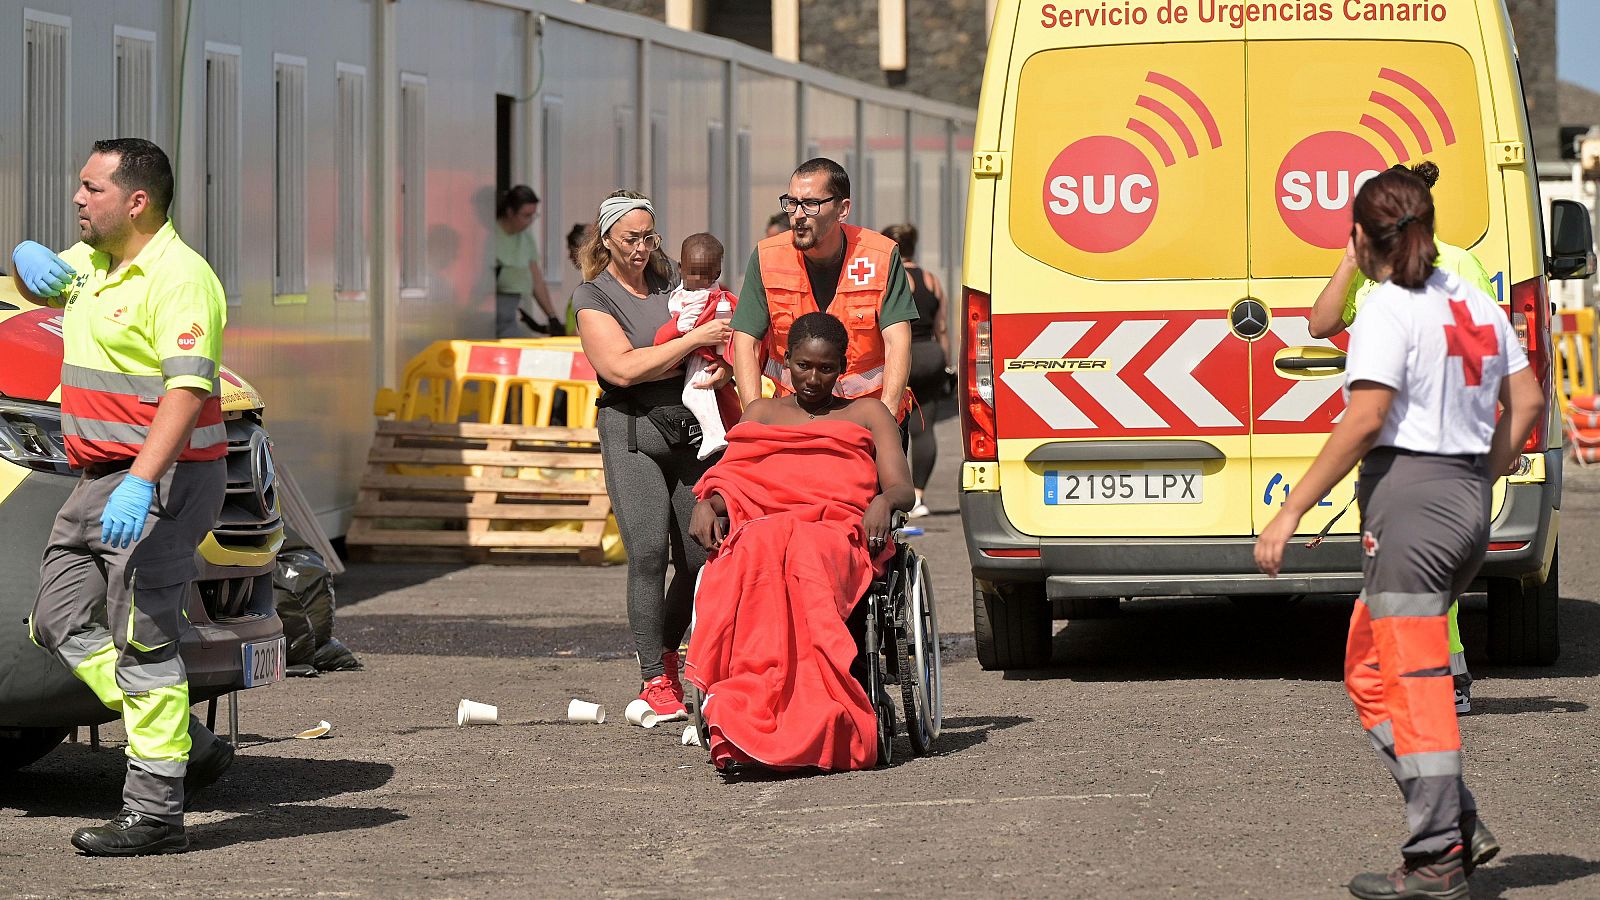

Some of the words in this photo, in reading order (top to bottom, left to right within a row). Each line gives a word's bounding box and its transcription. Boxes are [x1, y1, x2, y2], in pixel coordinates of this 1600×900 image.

[1041, 1, 1148, 28] Servicio
[1156, 0, 1188, 24] de
[1198, 0, 1333, 28] Urgencias
[1343, 0, 1447, 22] Canario
[1048, 173, 1153, 215] SUC
[1007, 360, 1107, 370] SPRINTER
[1047, 490, 1054, 498] E
[1065, 474, 1134, 500] 2195
[1144, 474, 1196, 499] LPX
[254, 647, 275, 681] 2203
